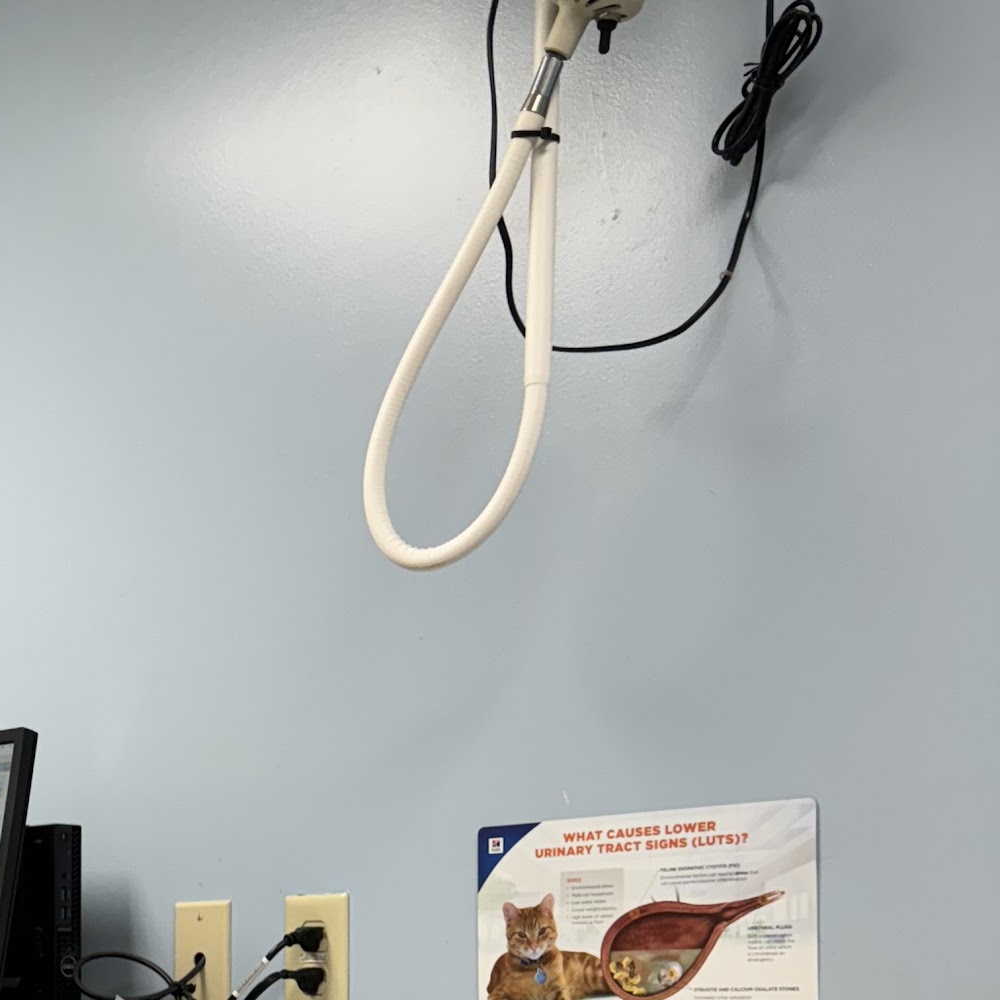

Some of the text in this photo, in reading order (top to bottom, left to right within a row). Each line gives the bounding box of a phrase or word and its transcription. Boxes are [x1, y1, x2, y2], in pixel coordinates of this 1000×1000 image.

[563, 821, 716, 843] WHAT CAUSES LOWER
[535, 832, 749, 859] URINARY TRACT SIGNS (LUTS)?
